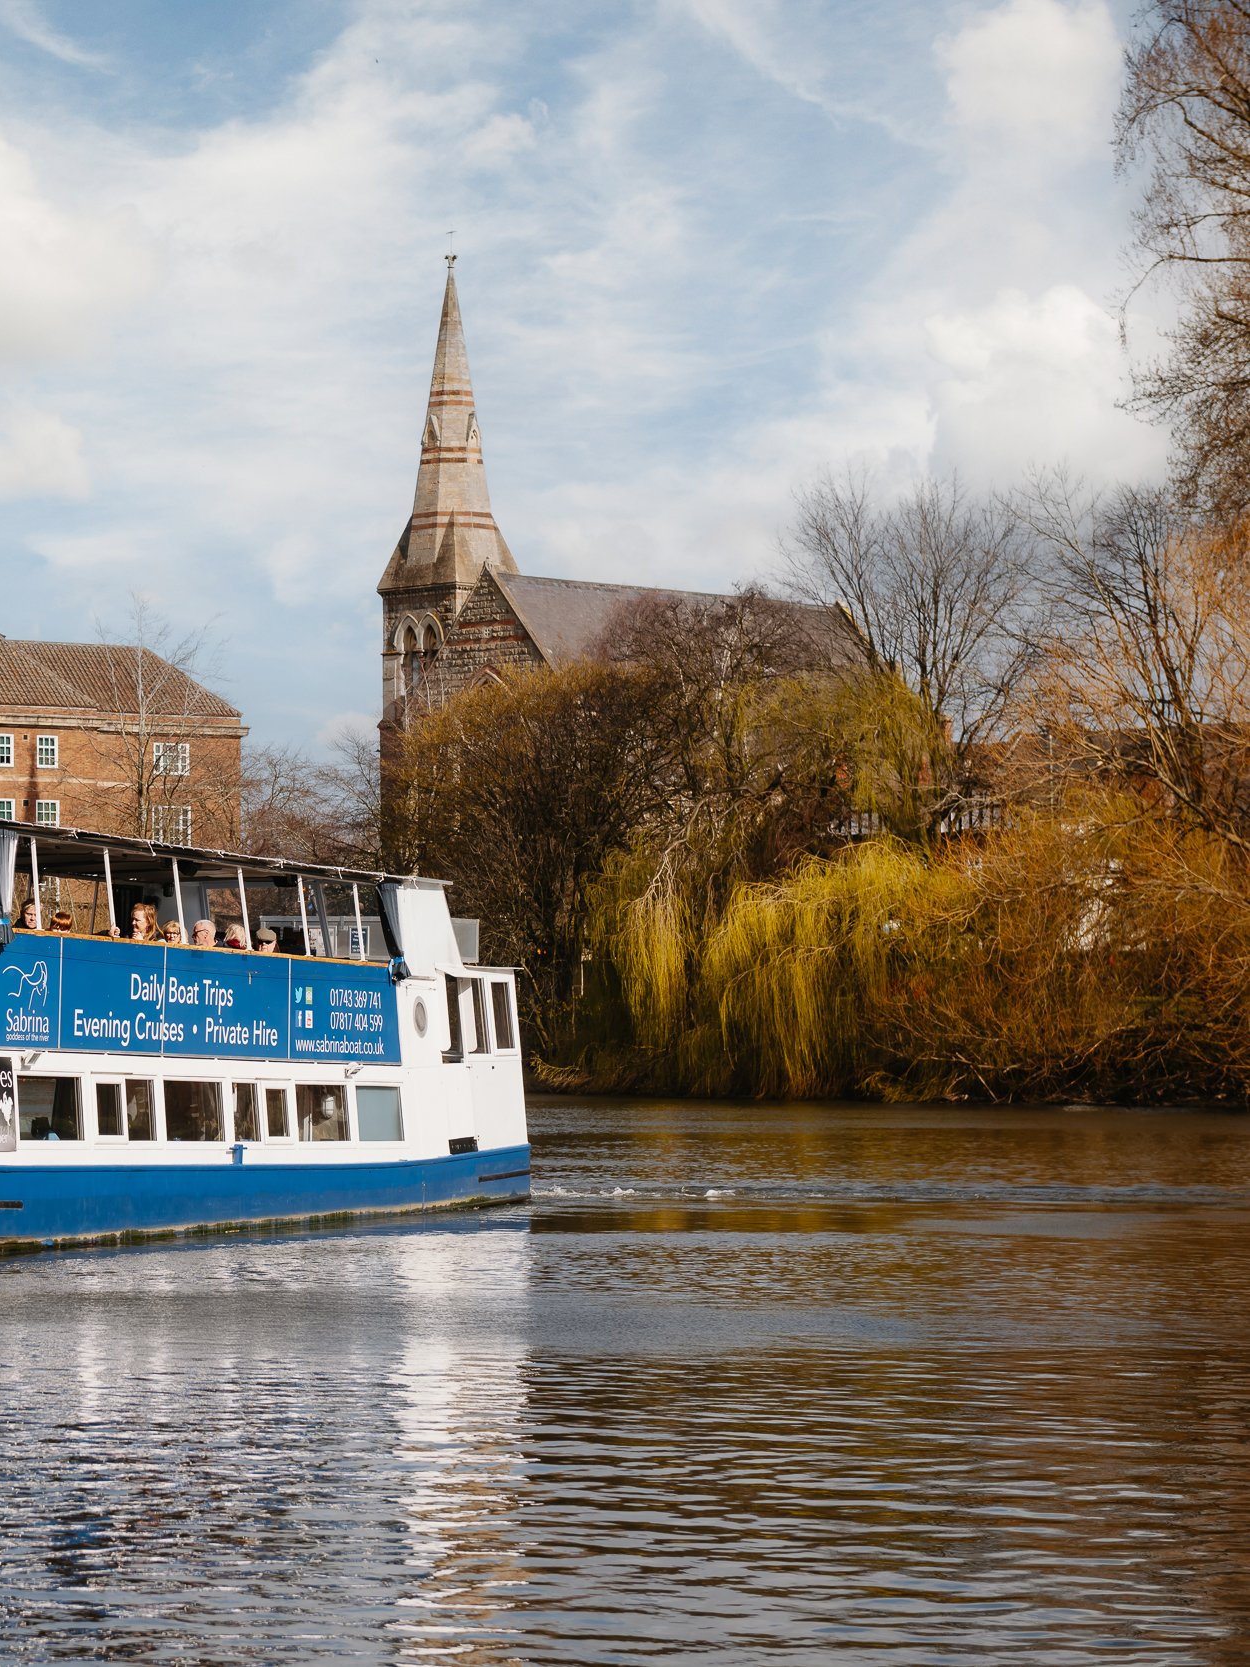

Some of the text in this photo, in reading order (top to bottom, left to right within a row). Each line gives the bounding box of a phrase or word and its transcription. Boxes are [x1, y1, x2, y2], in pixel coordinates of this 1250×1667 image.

[130, 973, 233, 1016] Daily Boat Trips
[330, 988, 382, 1010] 01743 369 741
[6, 1007, 50, 1033] Sabrina
[74, 1008, 278, 1047] Evening Cruises Private Hire
[330, 1011, 353, 1031] 07817
[354, 1013, 369, 1032] 404
[369, 1014, 384, 1032] 599
[6, 1033, 25, 1042] goddess
[31, 1033, 39, 1041] the
[39, 1034, 50, 1042] river
[295, 1033, 385, 1055] www.sabrinaboat.co.uk
